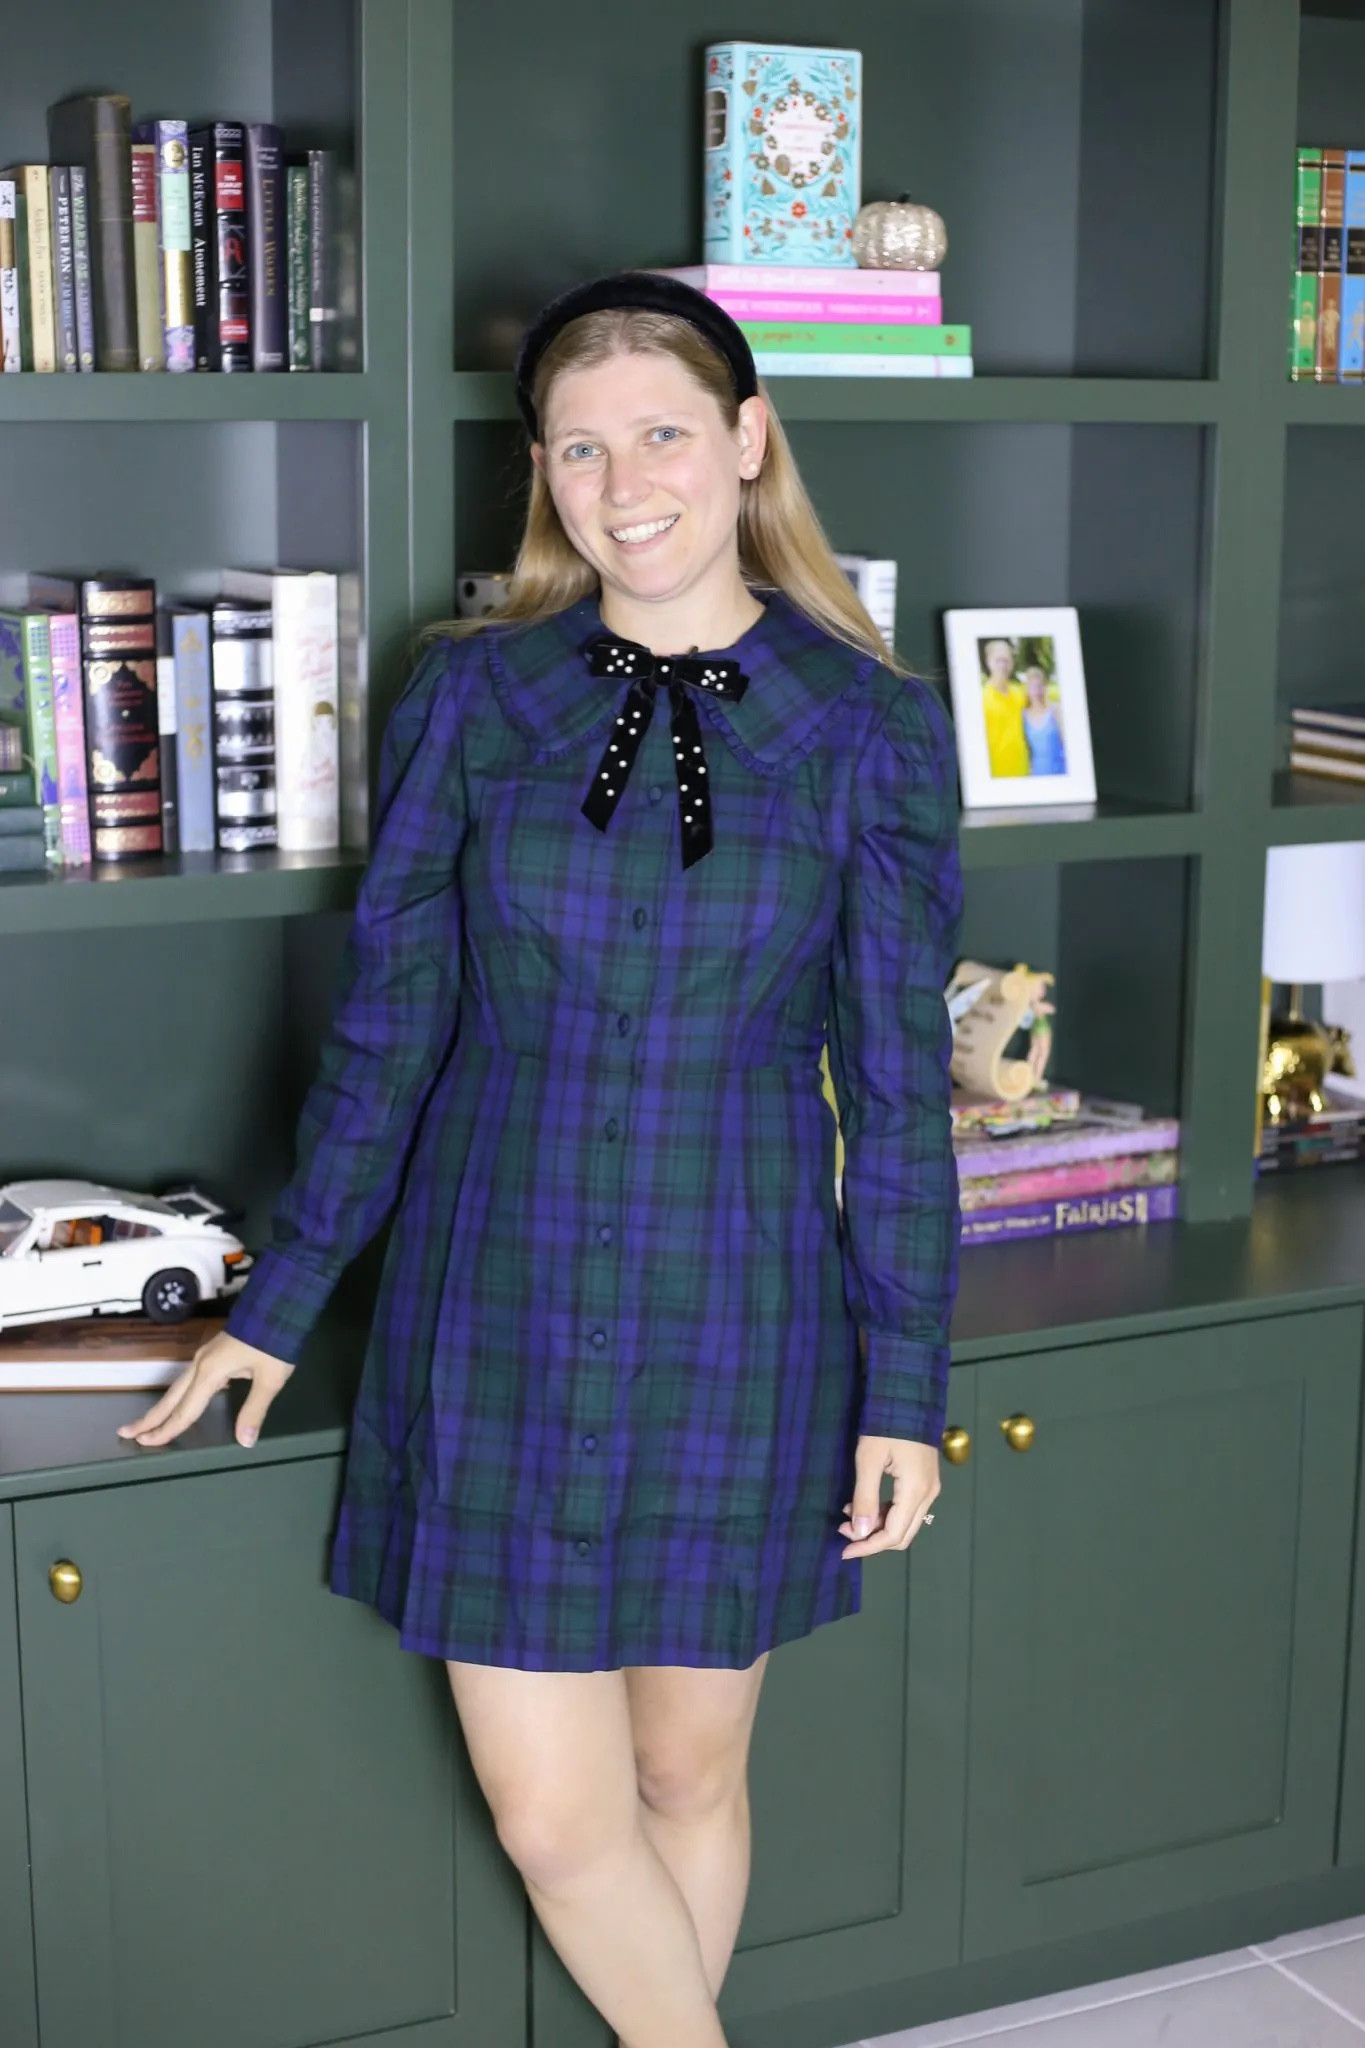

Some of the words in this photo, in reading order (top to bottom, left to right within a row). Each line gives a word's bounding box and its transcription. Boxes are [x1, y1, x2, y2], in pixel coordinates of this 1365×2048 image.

[192, 146, 204, 167] Ian
[73, 174, 83, 193] The
[193, 172, 206, 226] McEwan
[262, 179, 277, 233] LITTLE
[58, 196, 71, 244] PETER
[73, 196, 87, 247] WIZARD
[60, 247, 72, 273] PAN
[194, 238, 206, 307] Atonement
[263, 240, 277, 297] WOMEN
